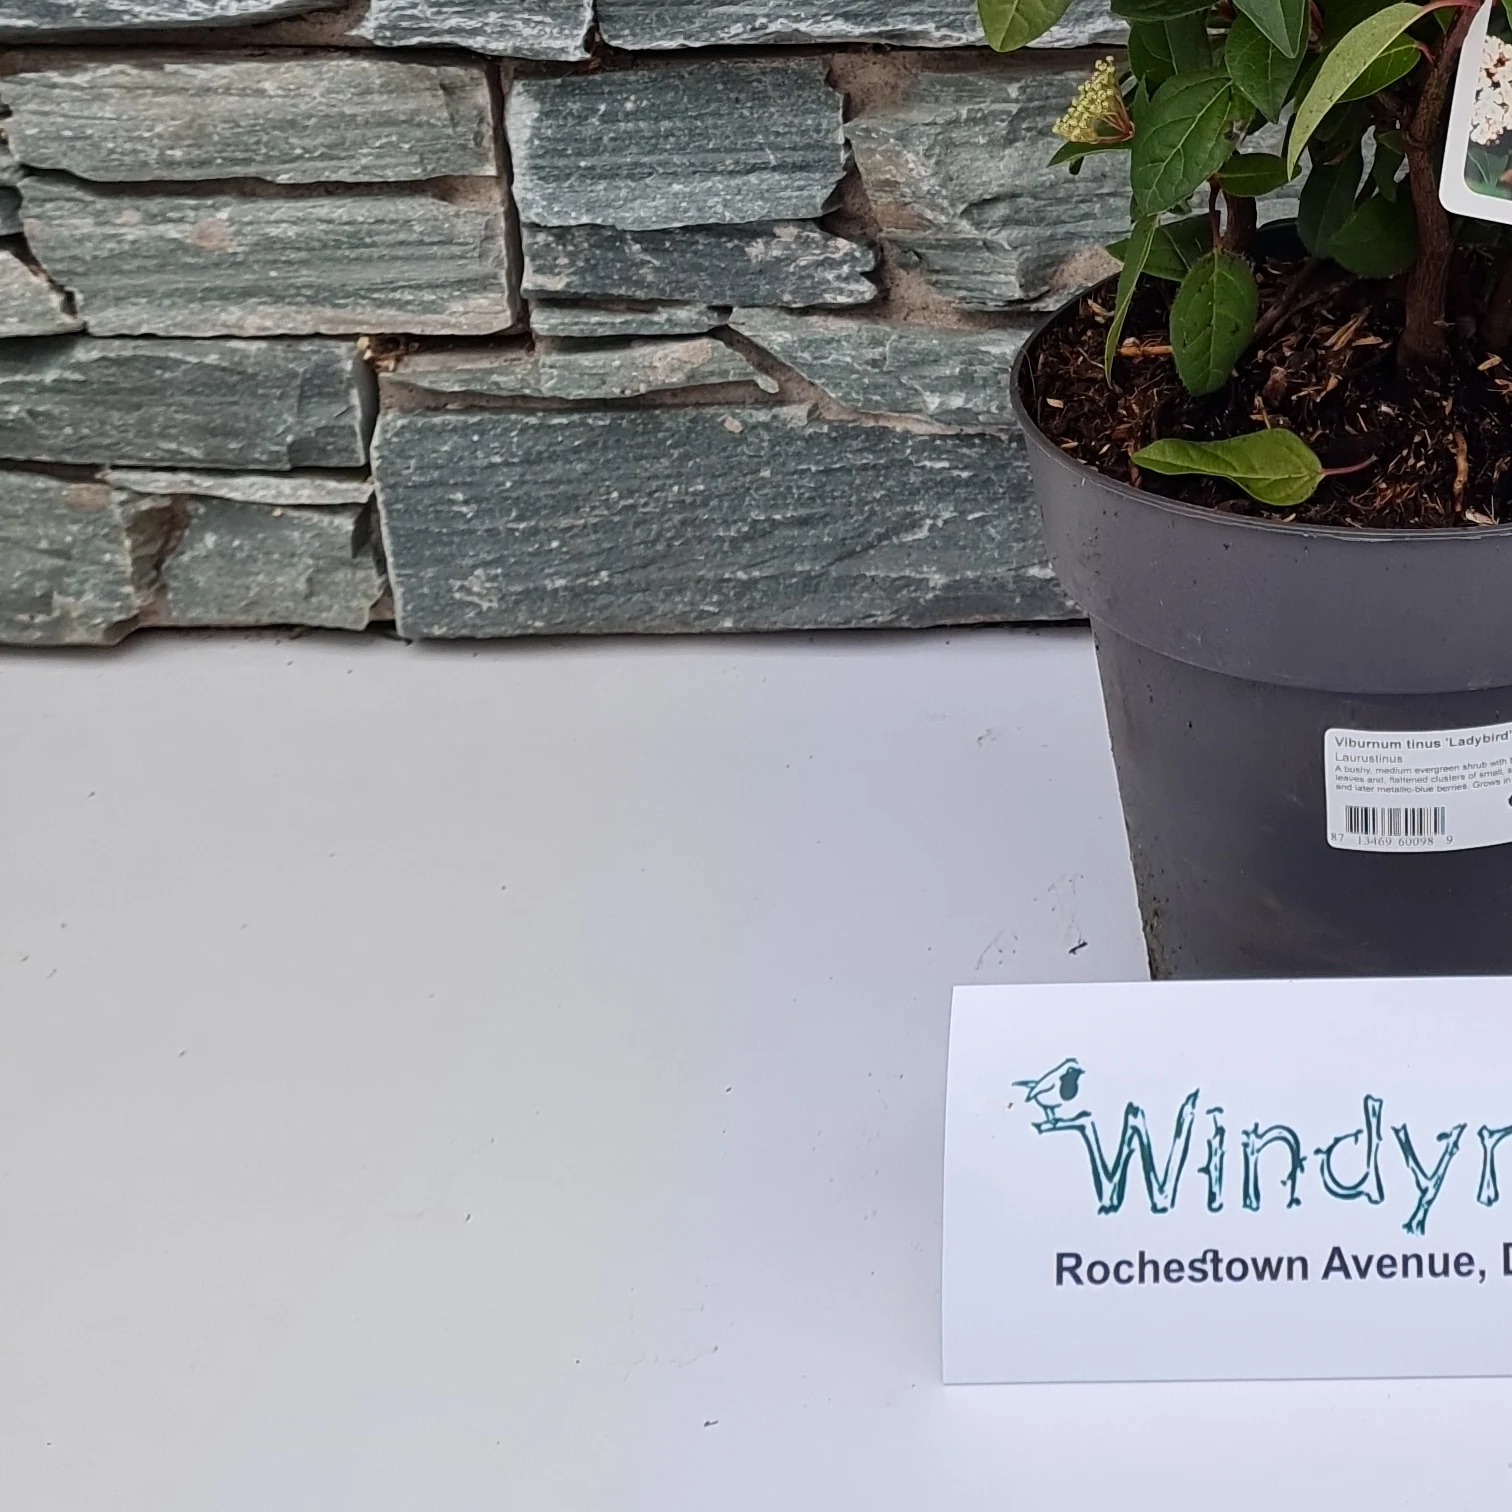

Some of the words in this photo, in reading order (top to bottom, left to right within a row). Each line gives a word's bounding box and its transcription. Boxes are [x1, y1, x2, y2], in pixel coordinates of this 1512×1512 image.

[1334, 736, 1402, 750] Viburnum
[1406, 739, 1441, 749] tinus
[1445, 729, 1512, 747] 'Ladybird'
[1335, 752, 1403, 764] Laurustinus
[1335, 765, 1342, 773] A
[1375, 767, 1412, 775] medium
[1414, 765, 1460, 774] evergreen
[1462, 761, 1488, 771] shrub
[1335, 775, 1365, 783] leaves
[1430, 774, 1465, 783] clusters
[1468, 771, 1477, 779] of
[1472, 778, 1501, 788] Grows
[1503, 776, 1511, 784] in
[1330, 833, 1344, 842] 87
[1357, 835, 1392, 846] 13469
[1398, 837, 1434, 846] 60098
[1446, 835, 1453, 844] 9
[1055, 1248, 1309, 1287] Rochestown
[1321, 1245, 1487, 1284] Avenue,
